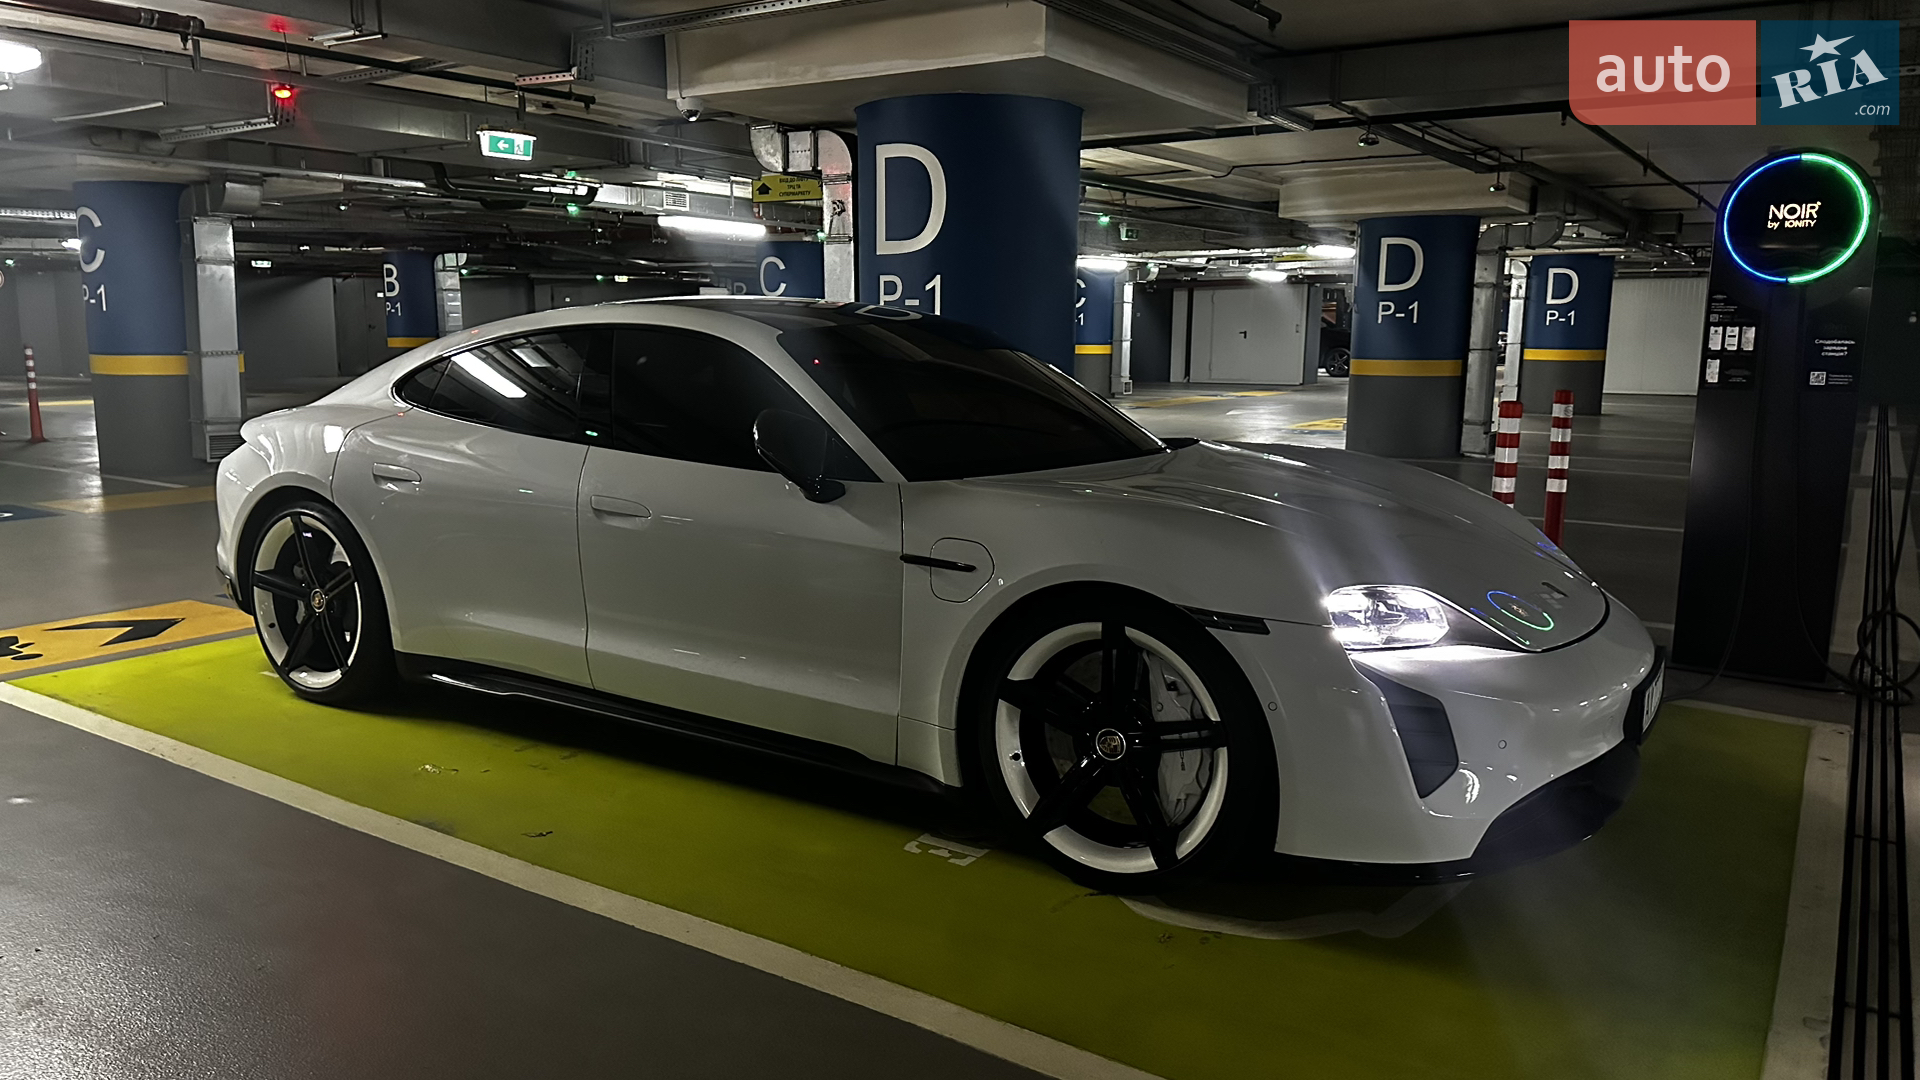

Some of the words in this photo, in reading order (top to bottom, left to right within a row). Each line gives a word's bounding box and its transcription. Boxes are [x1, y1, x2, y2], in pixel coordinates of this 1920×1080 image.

[875, 143, 947, 255] D
[1768, 203, 1819, 220] NOIR
[76, 206, 105, 273] C
[1767, 220, 1780, 230] by
[1784, 219, 1817, 229] IONITY
[383, 263, 400, 297] B
[759, 256, 787, 297] C
[1377, 236, 1424, 292] D
[879, 274, 941, 315] P-1
[1546, 267, 1579, 305] D
[385, 301, 402, 316] P-1
[1377, 300, 1419, 324] P-1
[1546, 310, 1575, 326] P-1
